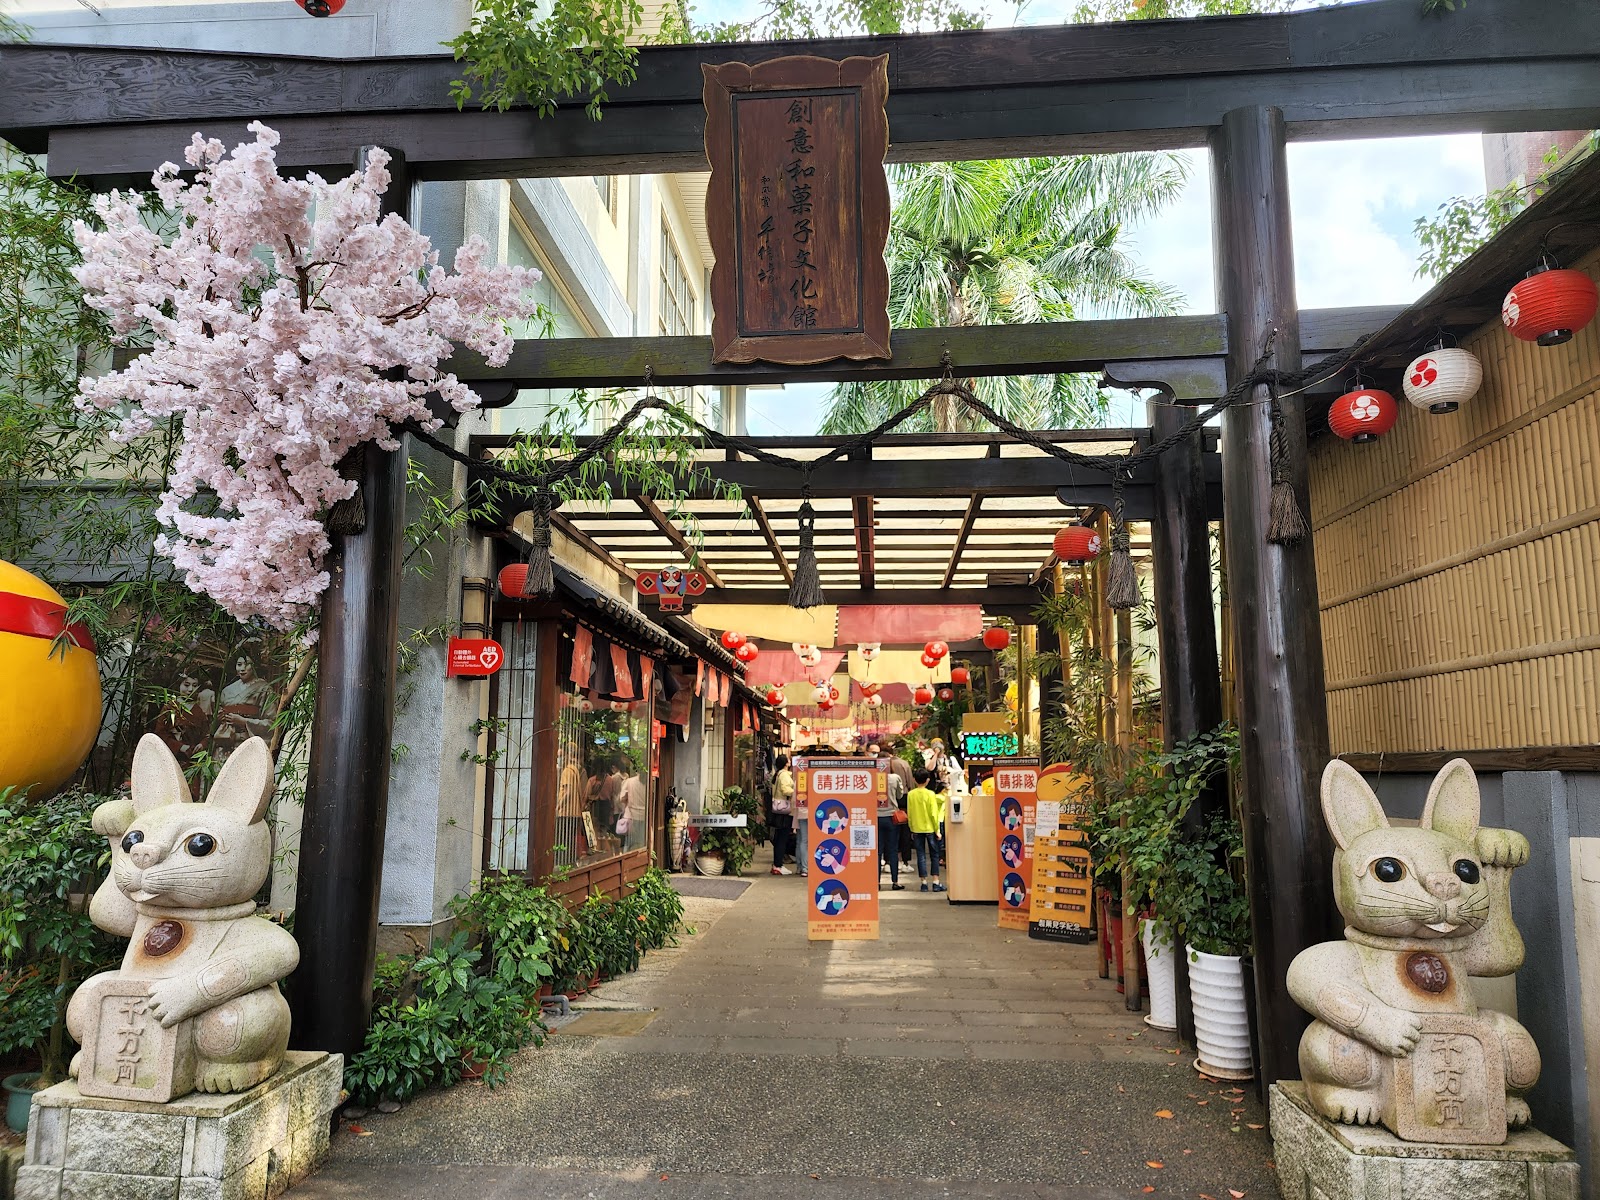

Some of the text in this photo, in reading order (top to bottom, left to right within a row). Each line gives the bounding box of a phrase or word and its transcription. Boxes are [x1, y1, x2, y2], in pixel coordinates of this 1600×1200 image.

[784, 98, 818, 329] 創意和菓子文化館
[817, 774, 868, 790] 請排隊
[1000, 773, 1036, 789] 請排隊
